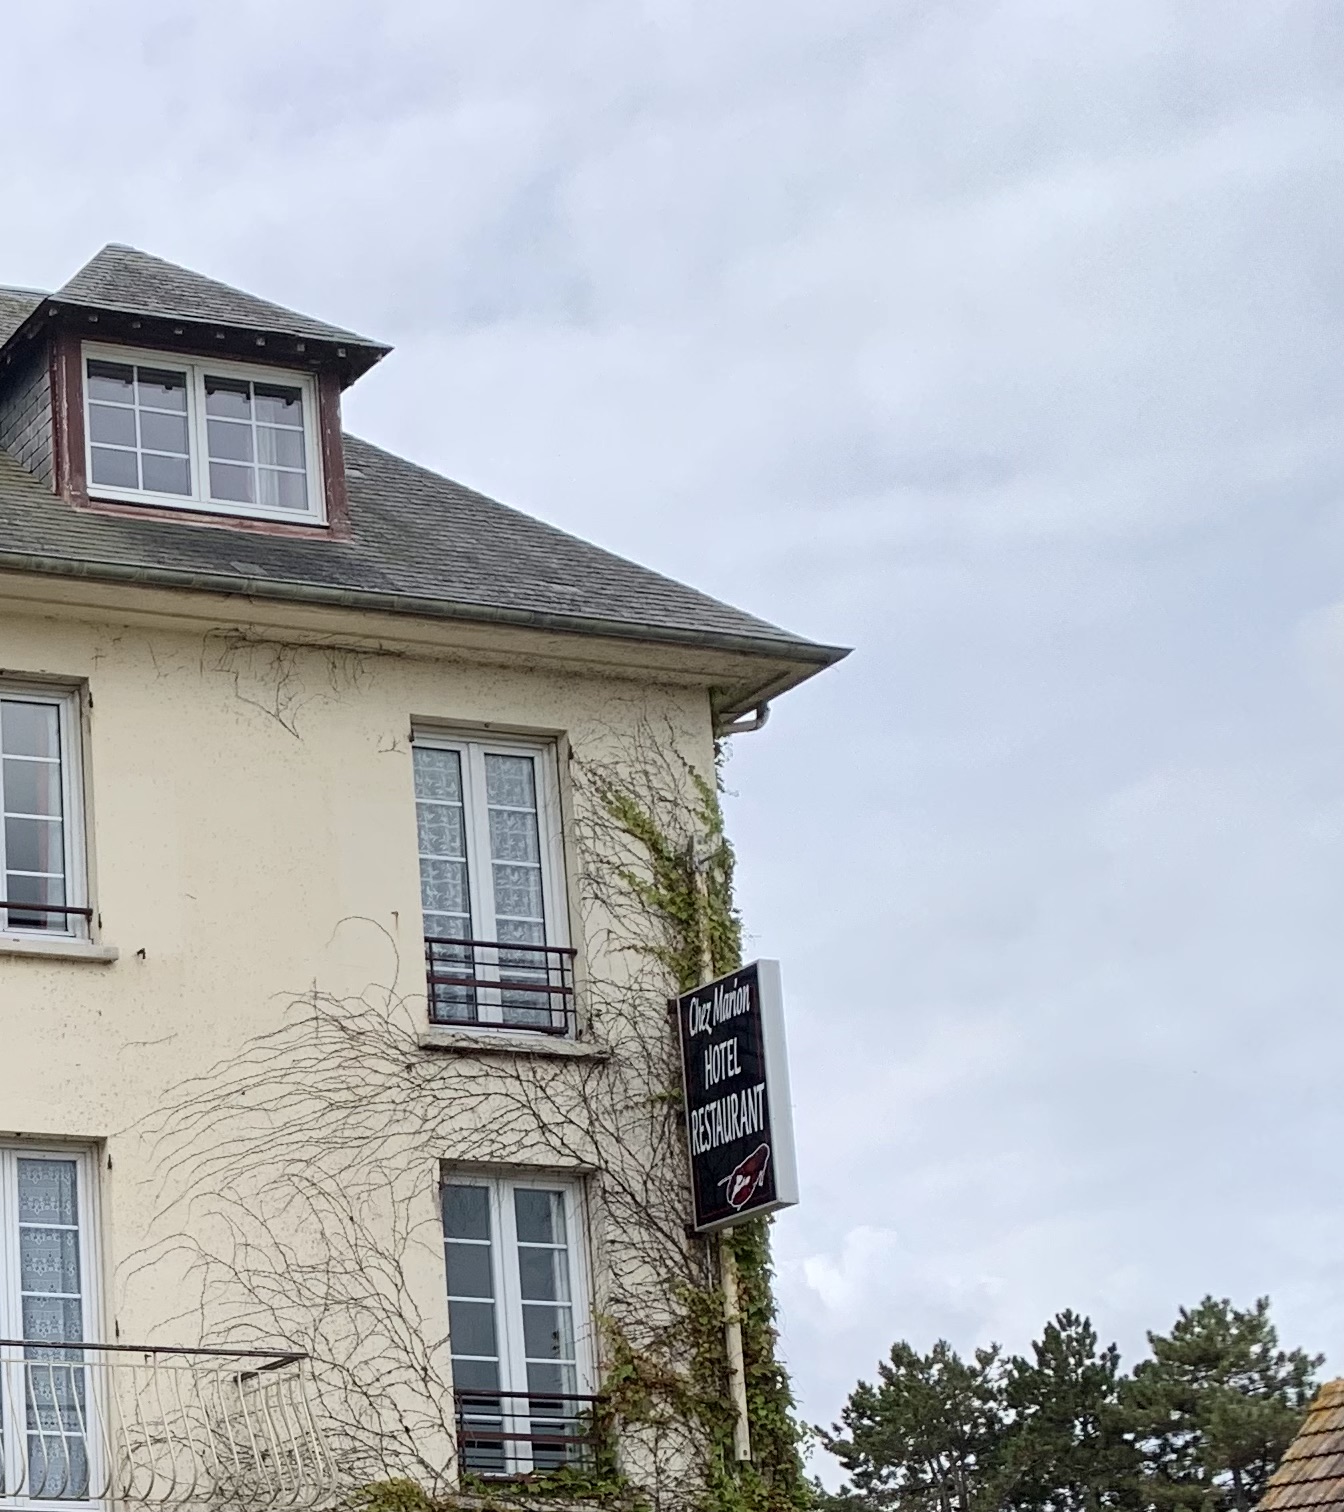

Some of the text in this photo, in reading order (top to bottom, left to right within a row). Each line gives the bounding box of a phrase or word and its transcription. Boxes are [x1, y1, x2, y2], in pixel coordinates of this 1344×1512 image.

[689, 978, 750, 1037] Chez Marion
[704, 1037, 742, 1090] HOTEL
[691, 1082, 766, 1156] RESTAURANT
